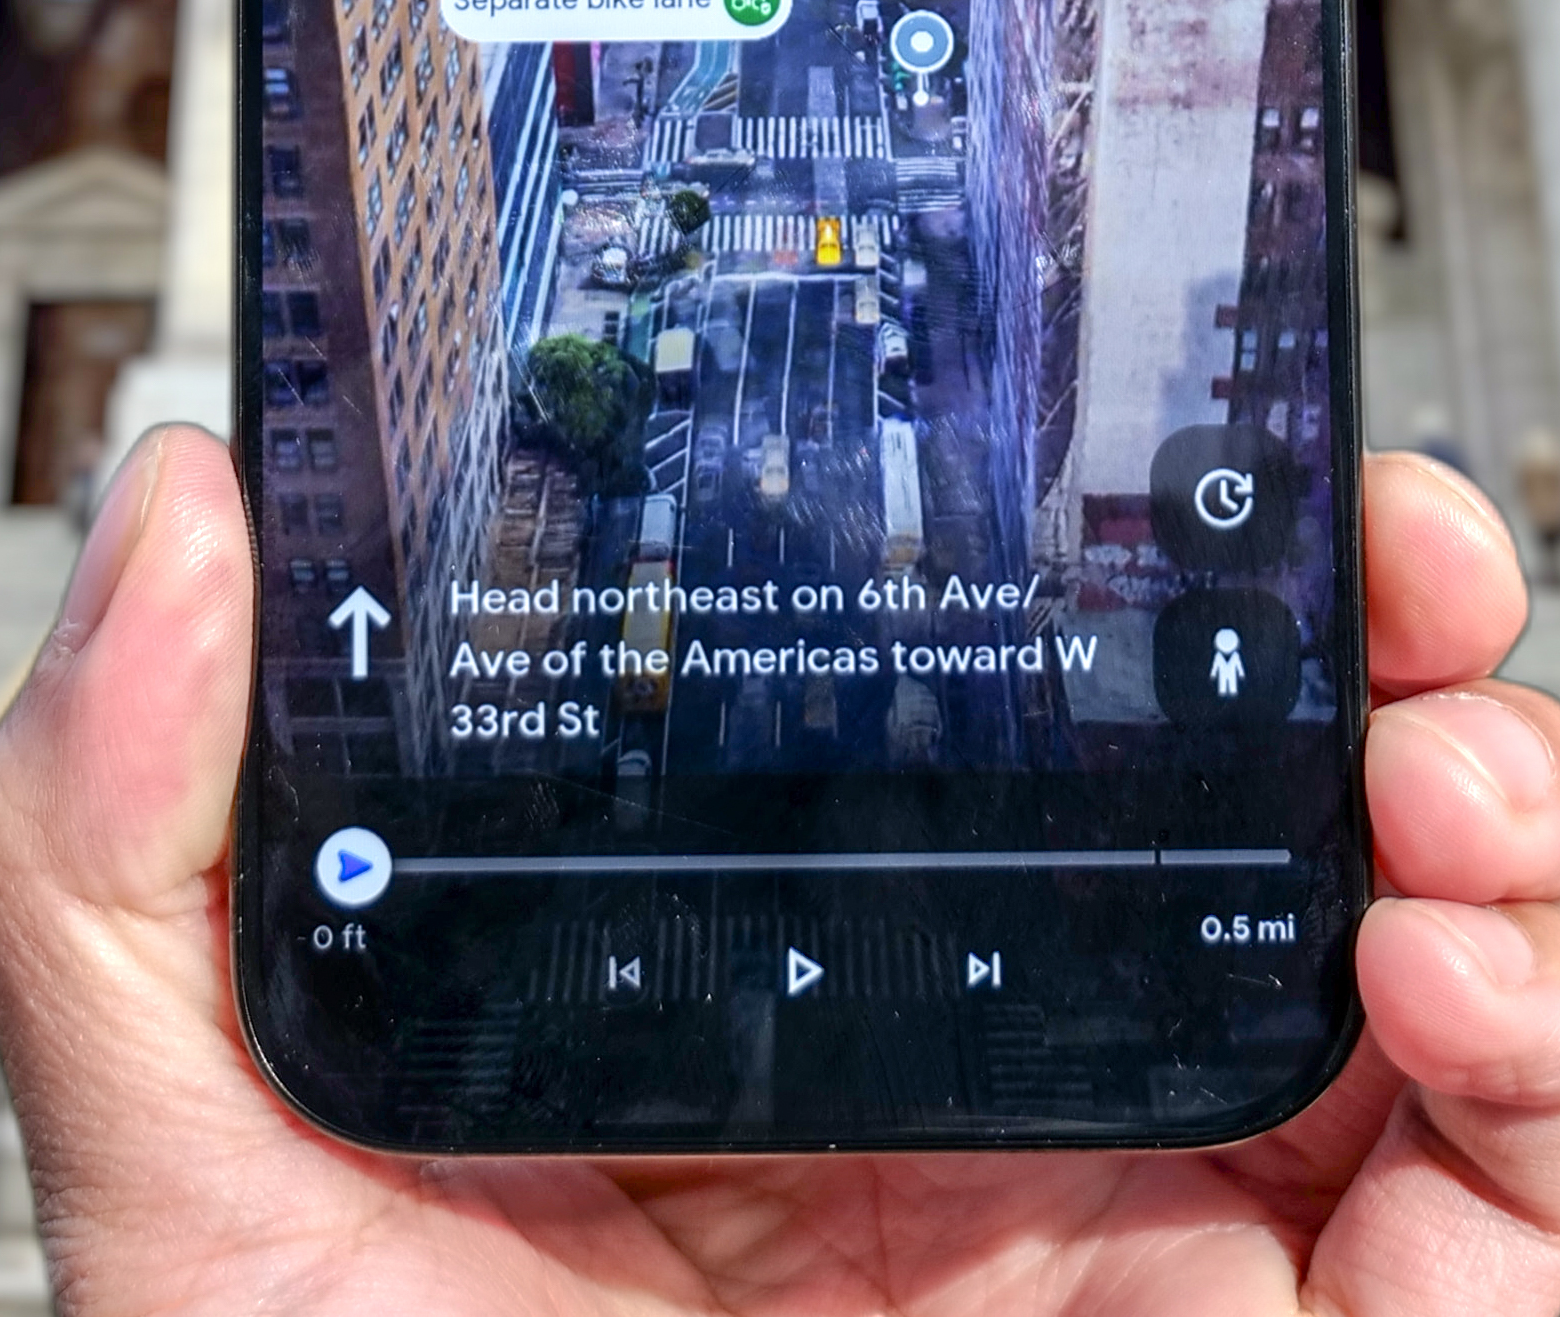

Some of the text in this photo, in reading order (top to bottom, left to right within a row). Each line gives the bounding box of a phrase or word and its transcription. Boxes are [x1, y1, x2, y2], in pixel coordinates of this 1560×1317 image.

[450, 574, 1040, 614] Head northeast on 6th Ave/
[449, 635, 1098, 678] Ave of the Americas toward W
[450, 701, 600, 739] 33rd St
[313, 922, 367, 951] 0 ft
[1200, 912, 1296, 943] 0.5 mi
